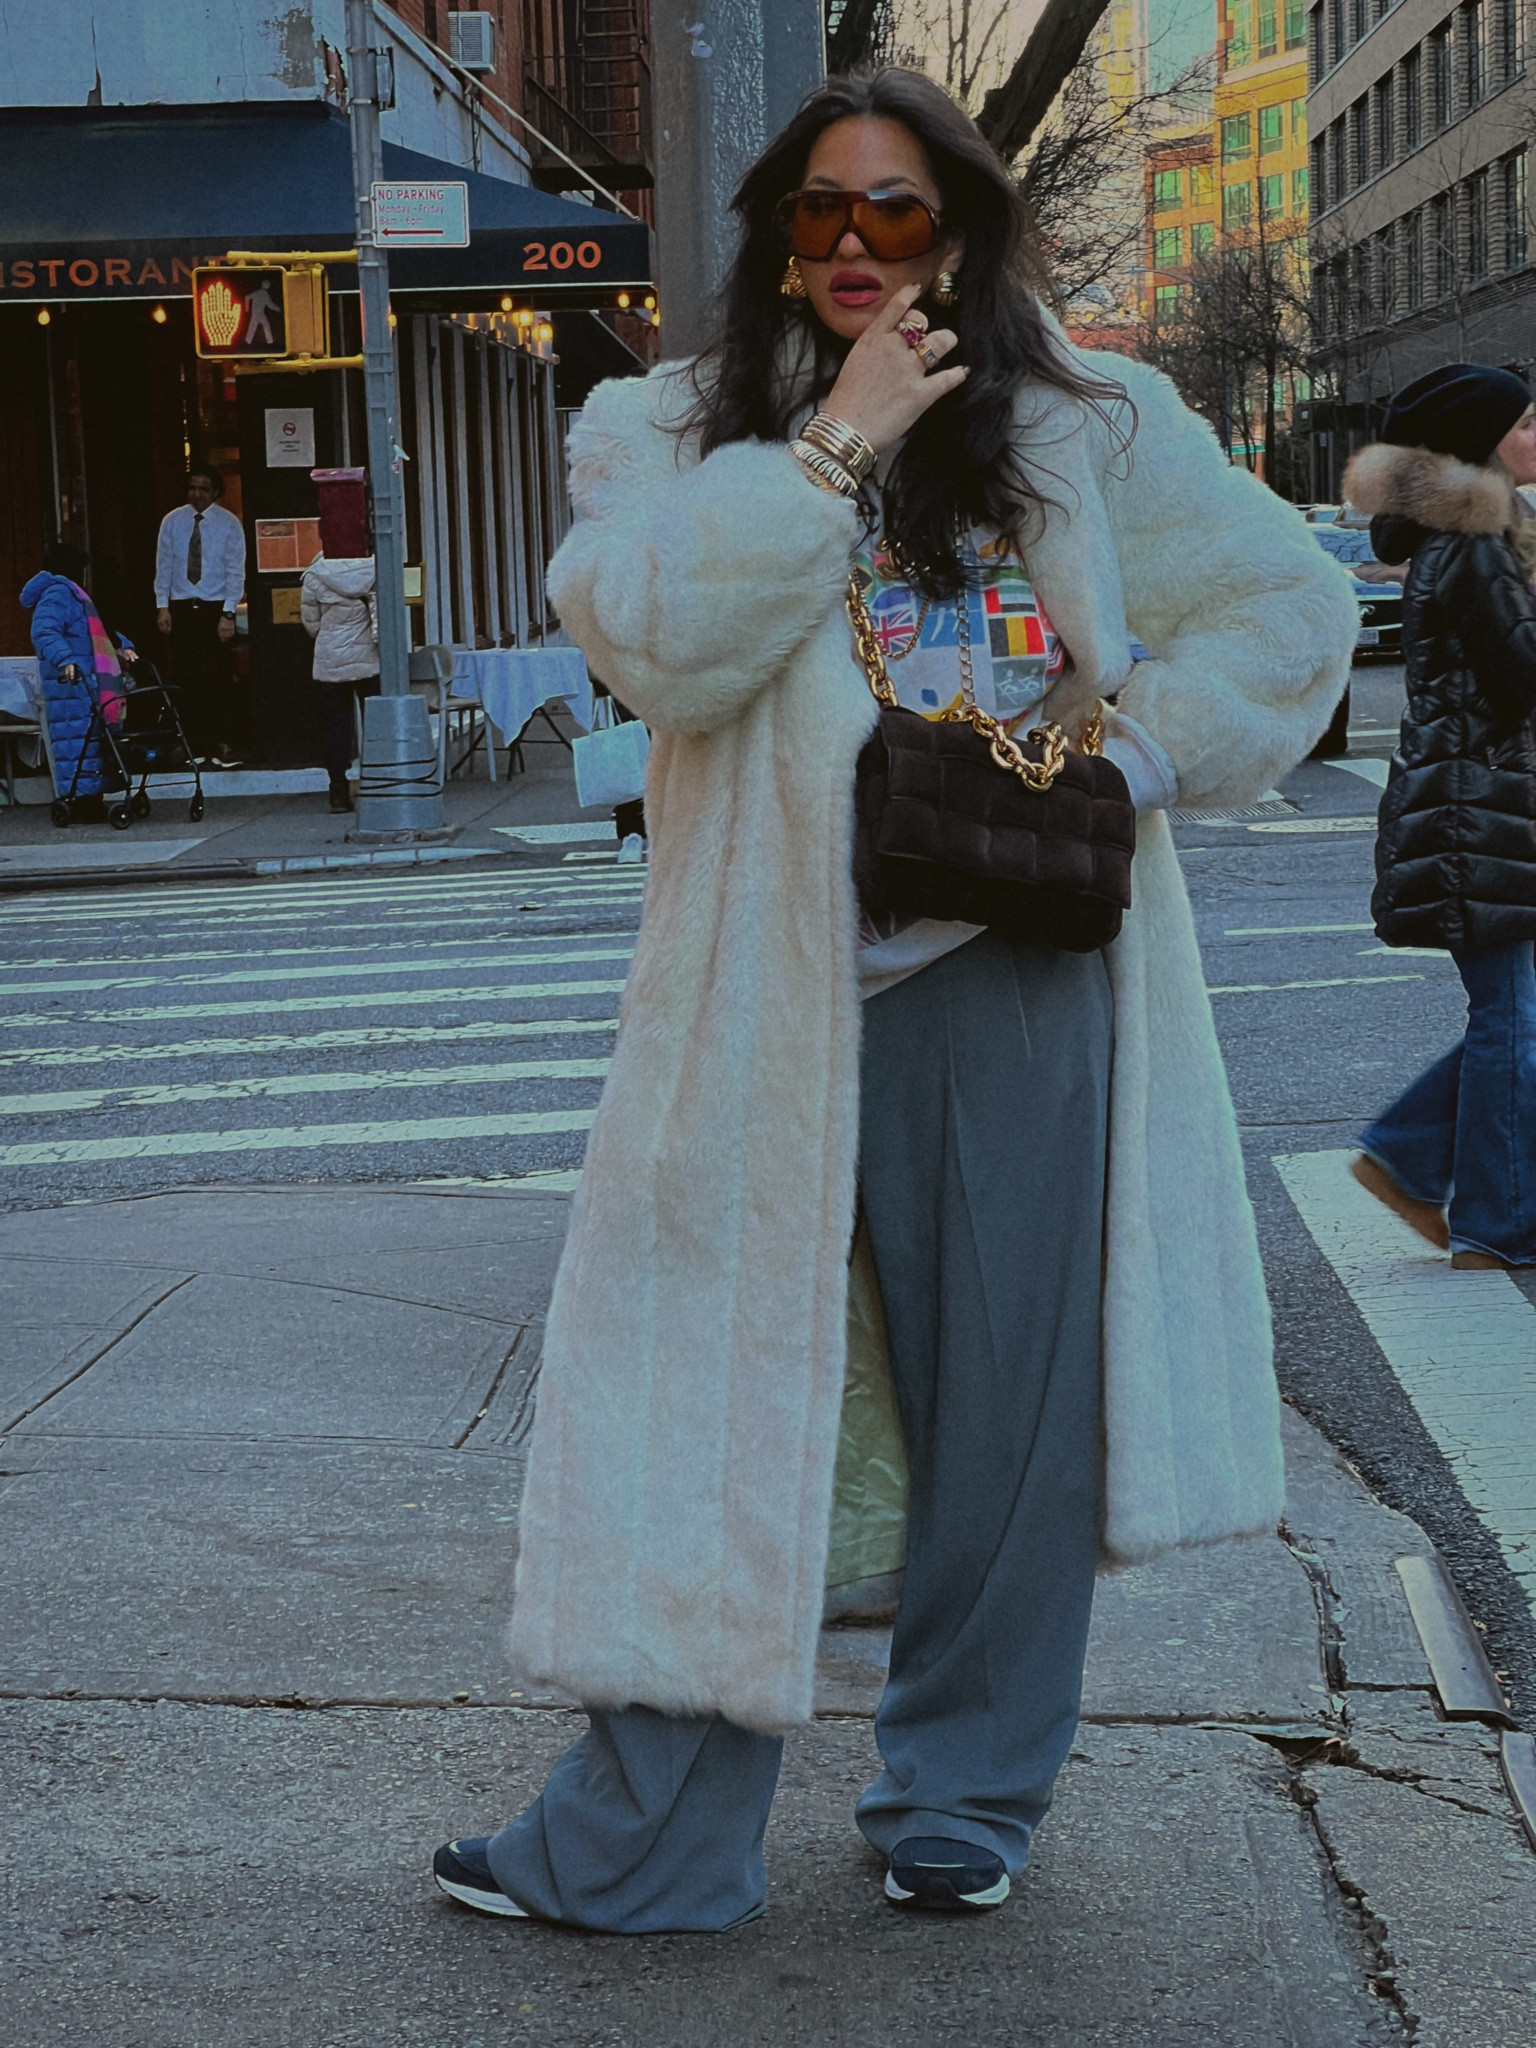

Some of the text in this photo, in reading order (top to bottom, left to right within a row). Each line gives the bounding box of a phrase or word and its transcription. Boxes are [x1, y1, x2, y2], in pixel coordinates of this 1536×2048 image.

[378, 189, 444, 200] NO PARKING
[379, 204, 410, 214] Monday
[419, 204, 444, 214] Friday
[523, 241, 602, 271] 200
